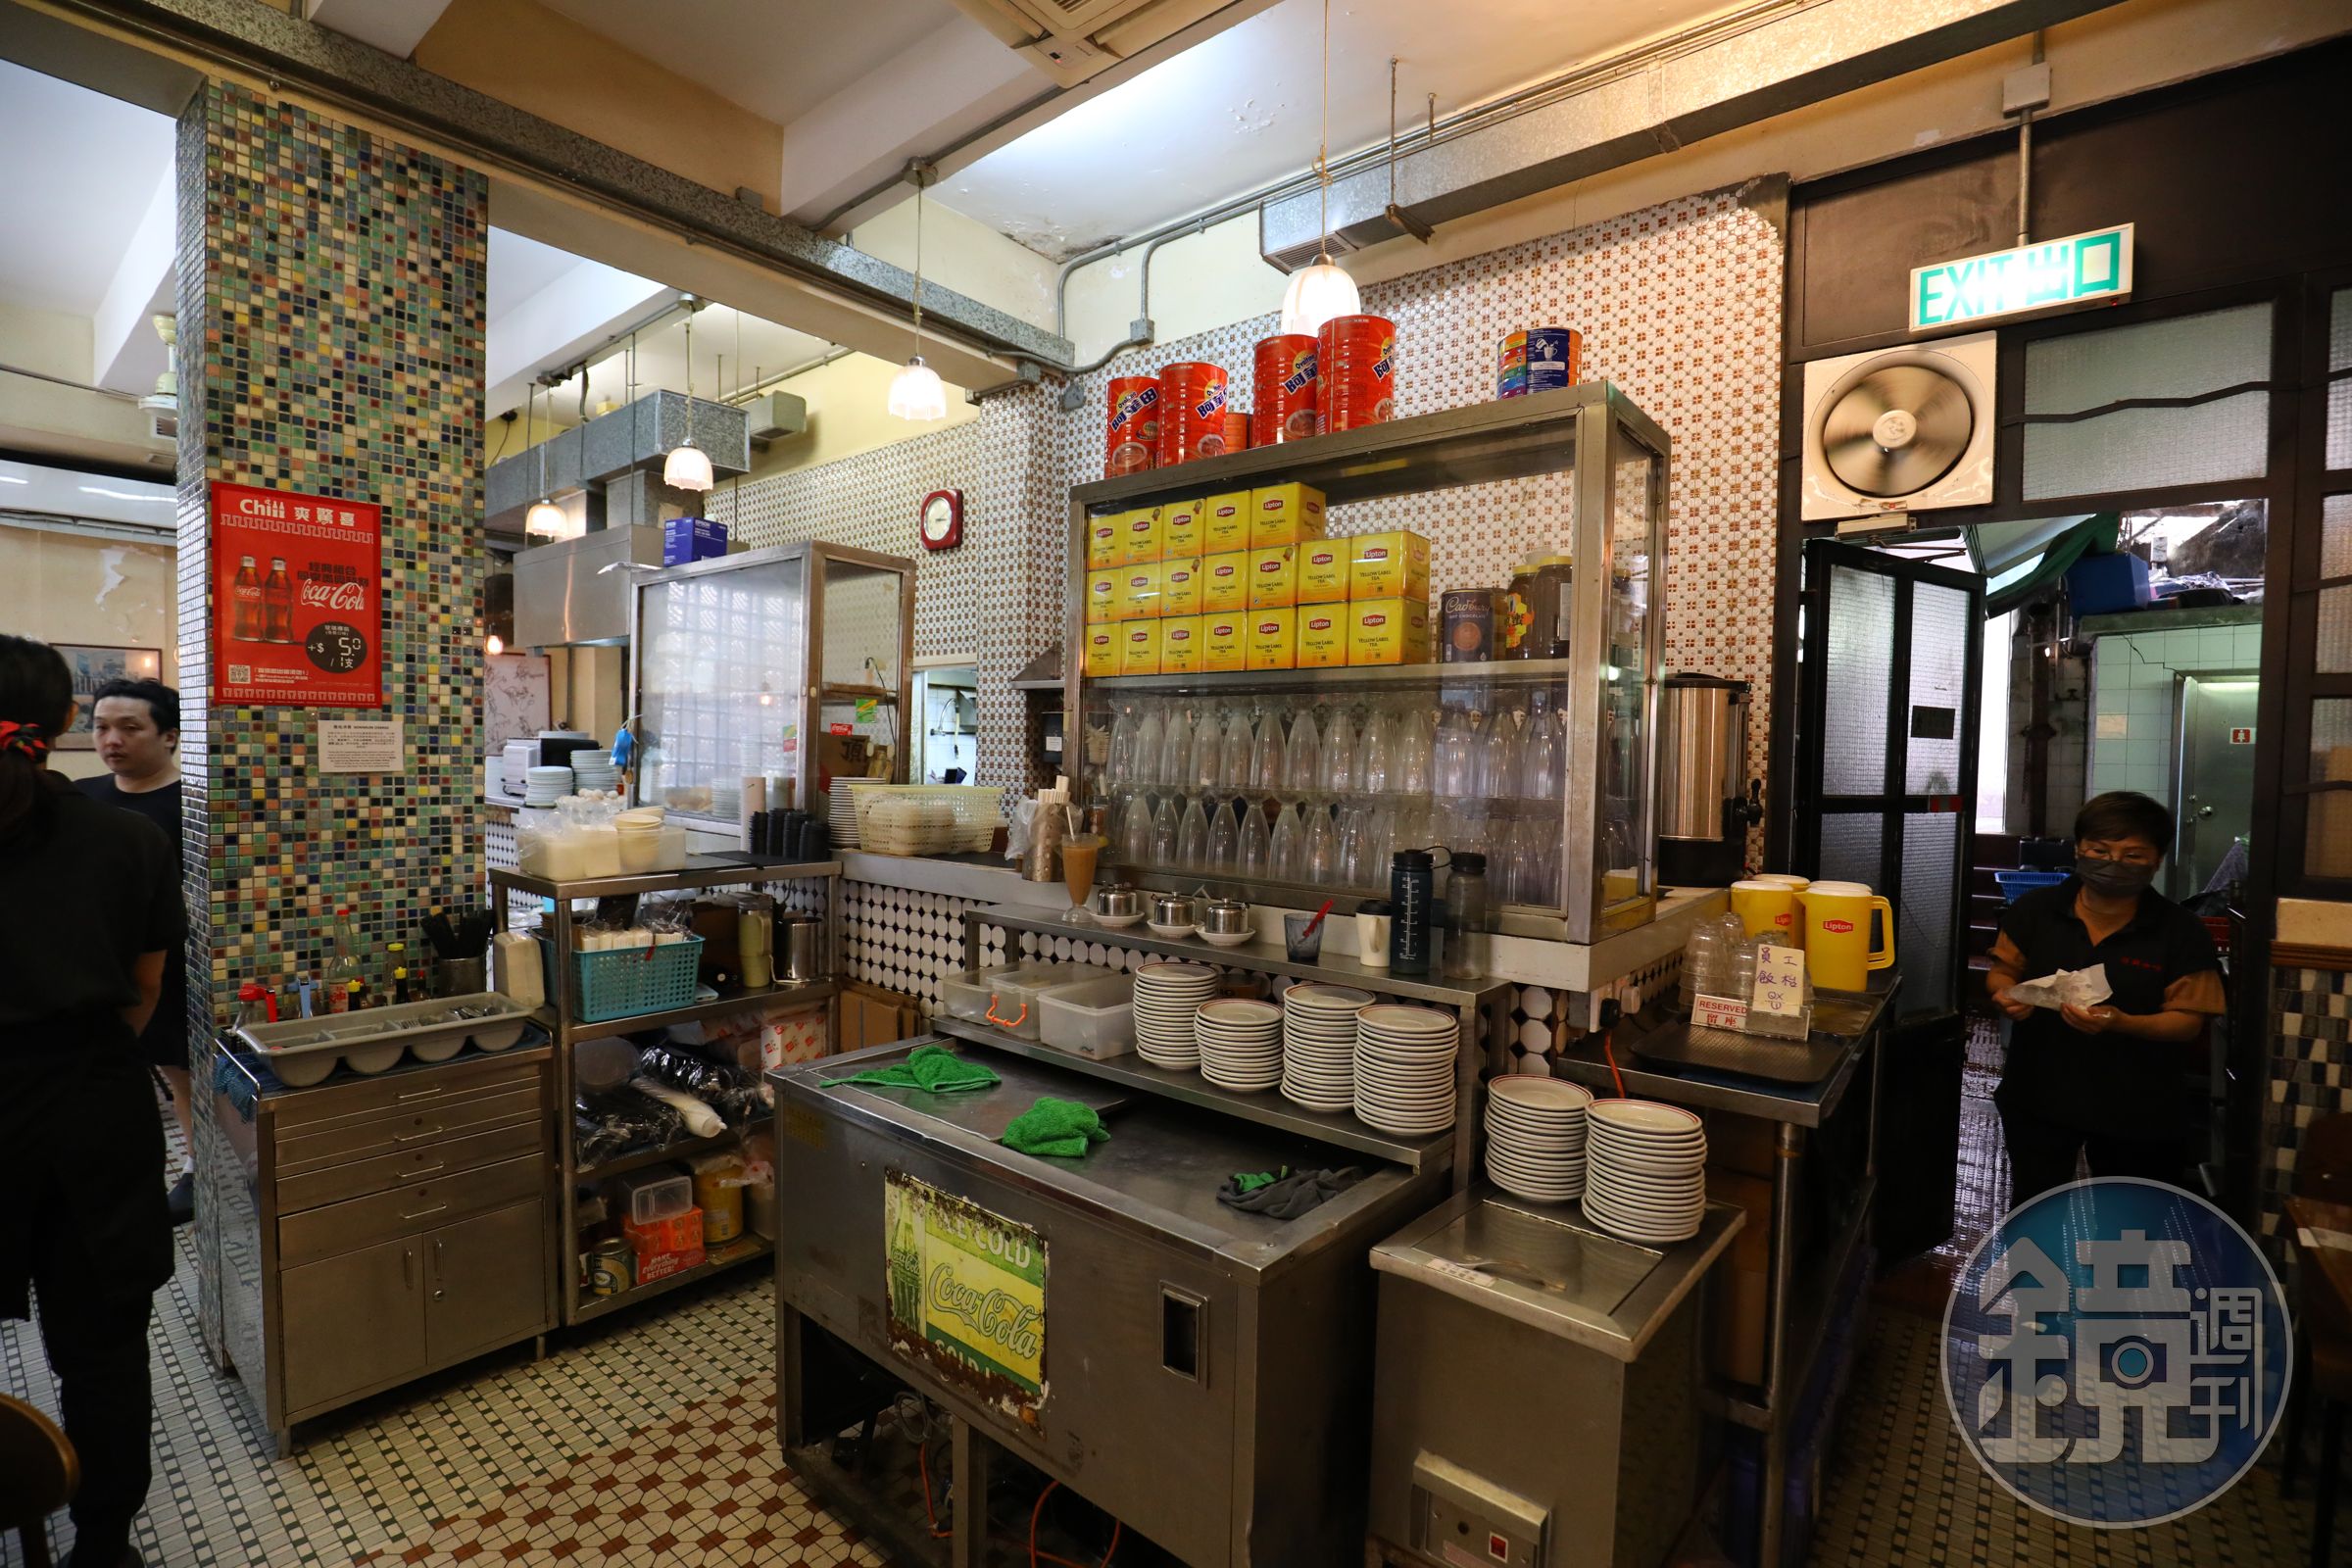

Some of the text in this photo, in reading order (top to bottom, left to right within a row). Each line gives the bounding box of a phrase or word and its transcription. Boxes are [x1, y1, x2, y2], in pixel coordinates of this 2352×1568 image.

[2026, 231, 2121, 306] 出口
[1919, 254, 2014, 325] EXIT
[1264, 501, 1282, 511] Lipton
[1218, 508, 1234, 516] Lipton
[1313, 555, 1332, 564] Lipton
[1365, 549, 1387, 559] Lipton
[1216, 566, 1233, 576] Lipton
[1261, 563, 1280, 572] Lipton
[1172, 573, 1188, 582] Lipton
[1446, 596, 1490, 613] Cadbury
[1310, 619, 1330, 630] Lipton
[1363, 615, 1384, 626] Lipton
[1215, 627, 1232, 636] Lipton
[1260, 624, 1279, 634] Lipton
[1824, 921, 1852, 932] Lipton
[1698, 1000, 1747, 1014] RESERVED
[1706, 1013, 1738, 1027] 留座
[893, 1249, 920, 1274] Coca-Cola
[928, 1262, 1043, 1359] Coca-Cola
